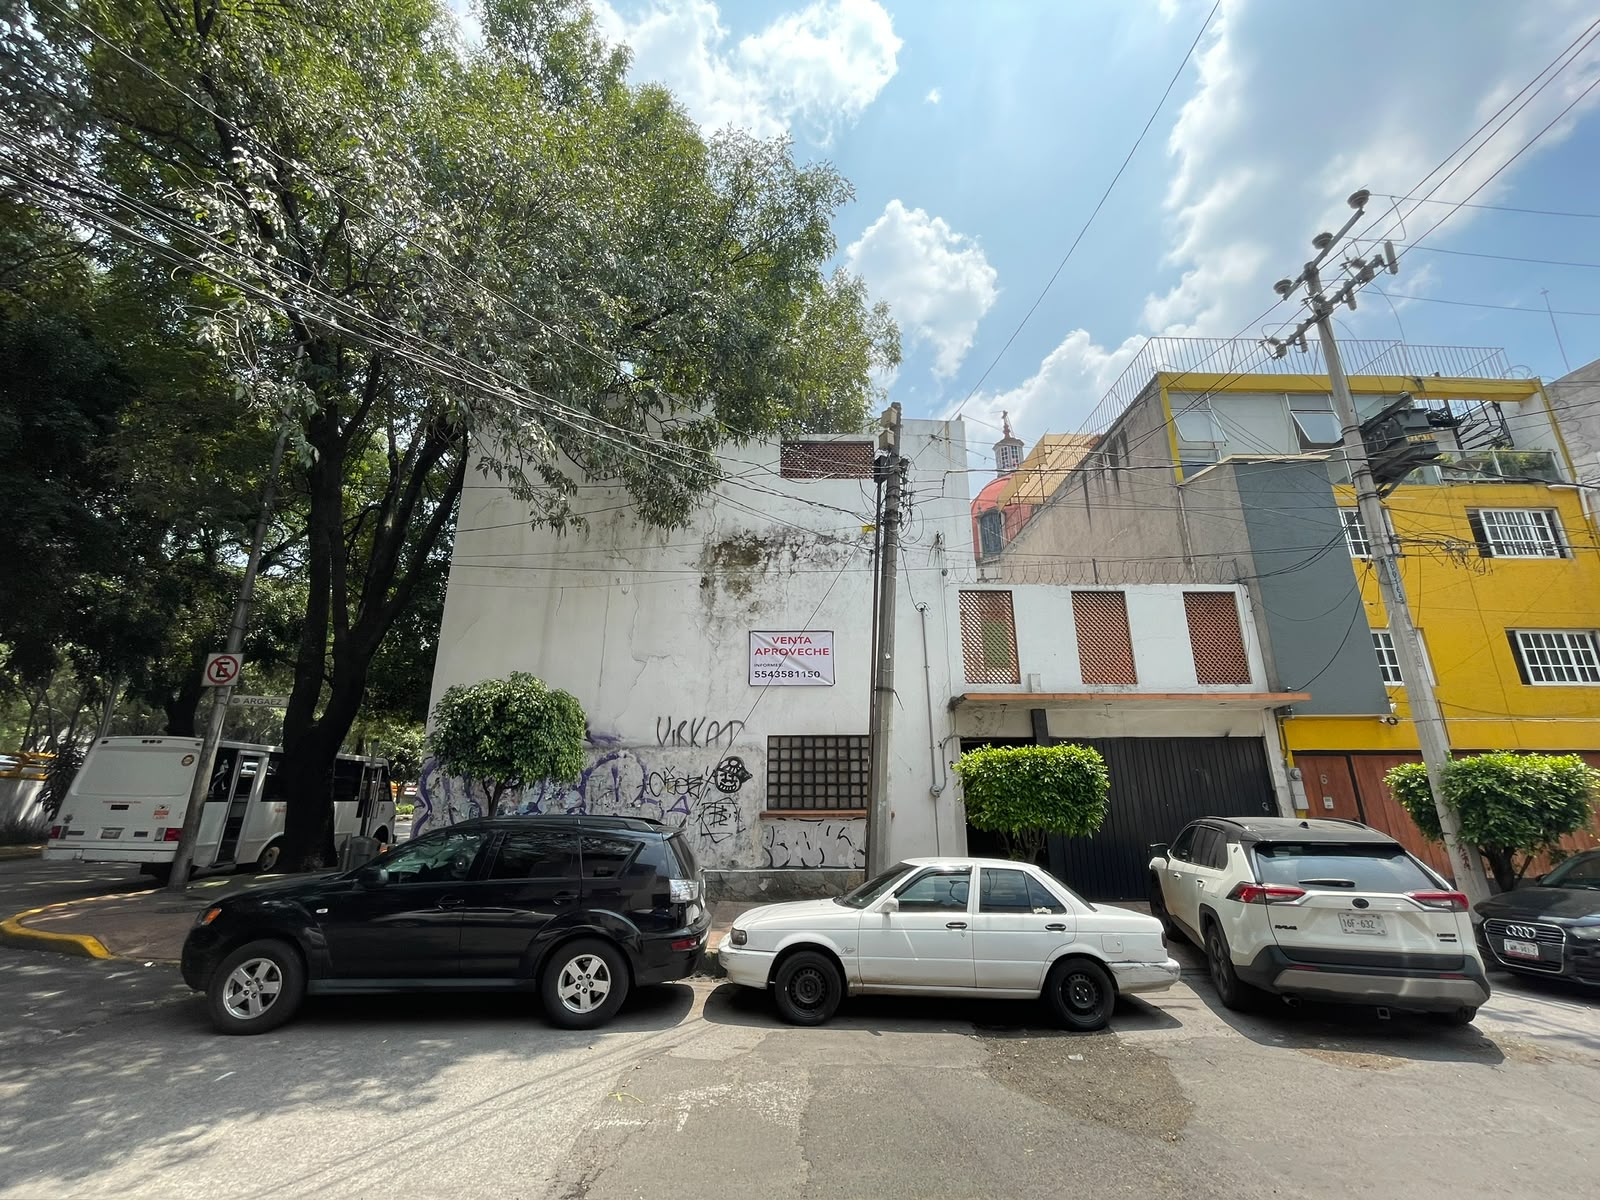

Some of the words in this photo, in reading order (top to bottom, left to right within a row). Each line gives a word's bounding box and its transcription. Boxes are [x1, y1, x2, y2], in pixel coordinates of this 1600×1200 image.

[772, 636, 812, 645] VENTA
[754, 647, 830, 656] APROVECHE
[754, 670, 821, 679] 5543581150
[243, 697, 283, 706] ARGAEZ
[1320, 774, 1328, 785] 6
